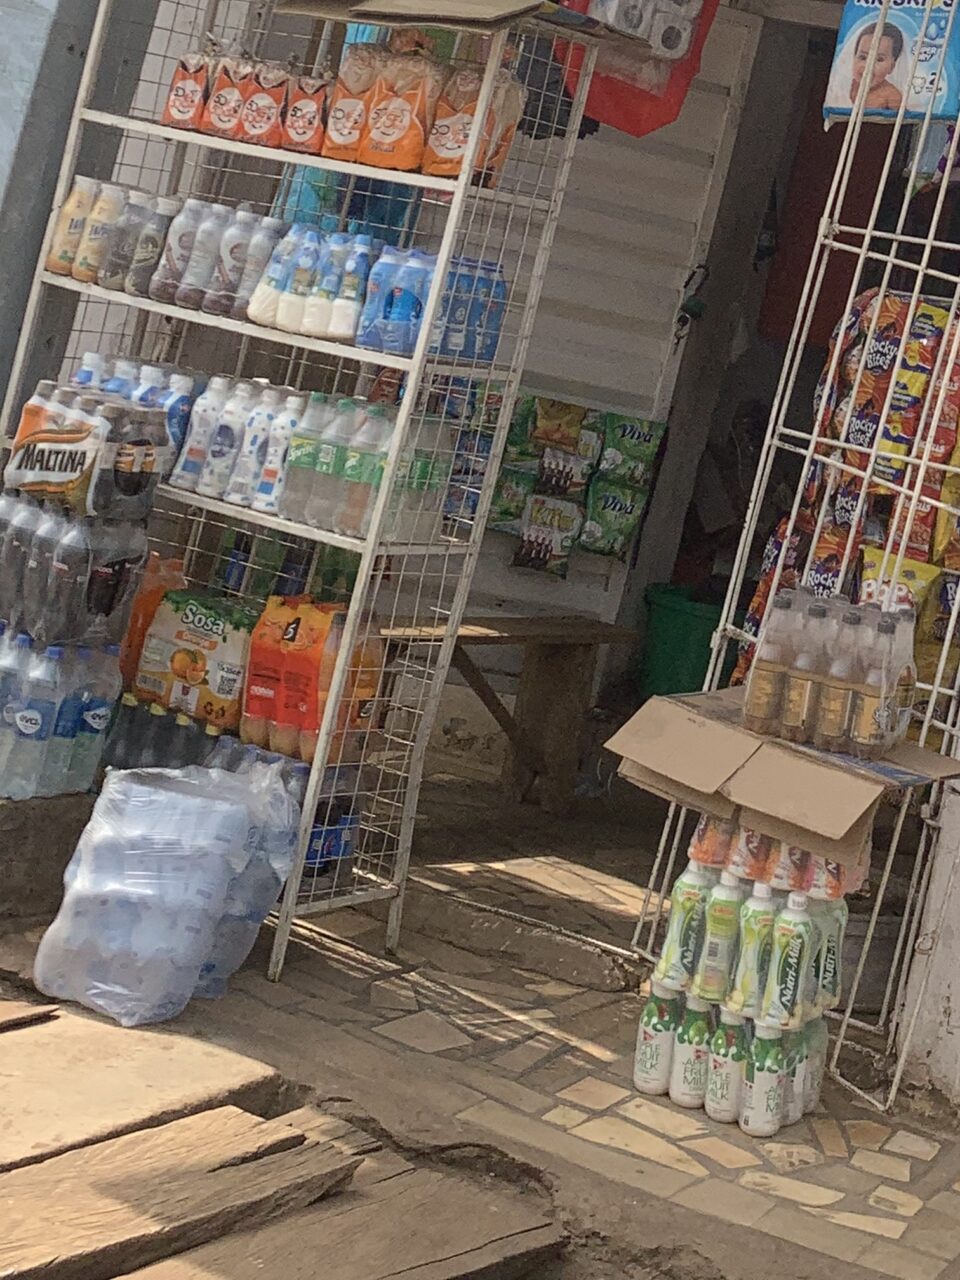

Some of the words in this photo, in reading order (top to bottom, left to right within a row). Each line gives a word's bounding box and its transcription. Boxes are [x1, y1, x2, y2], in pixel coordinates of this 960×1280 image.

[619, 423, 654, 443] Viva
[17, 444, 87, 472] MALTINA
[600, 494, 637, 515] Viva
[181, 604, 224, 635] Sosa
[779, 933, 802, 1006] Nutri-Milk
